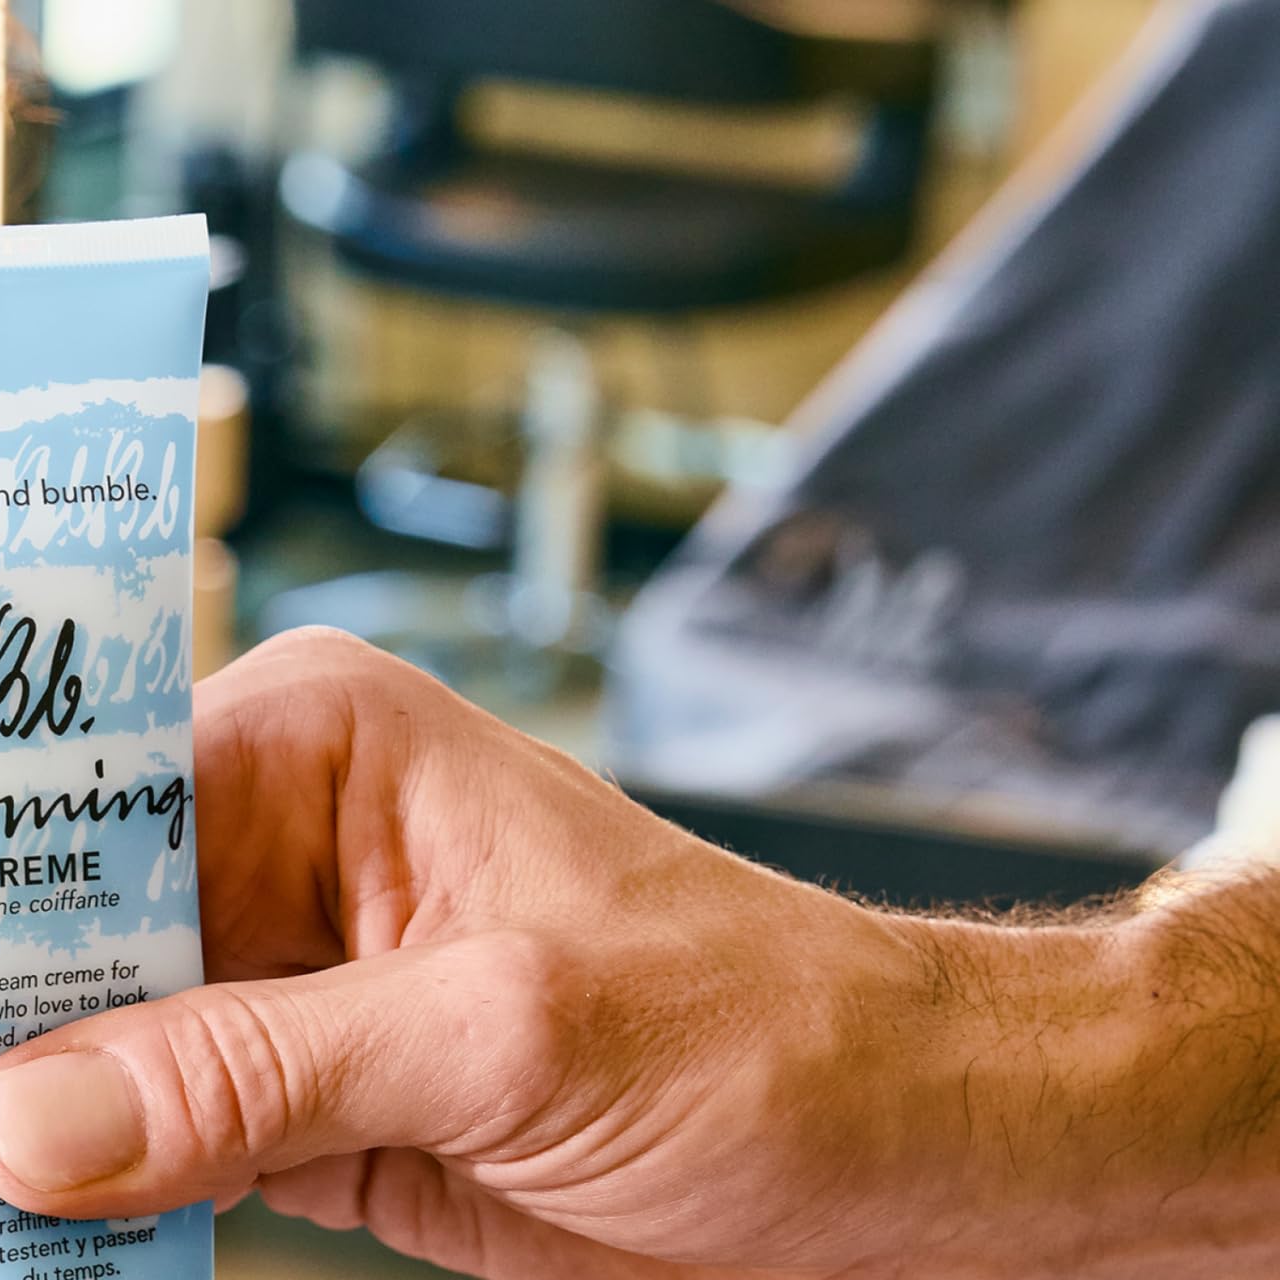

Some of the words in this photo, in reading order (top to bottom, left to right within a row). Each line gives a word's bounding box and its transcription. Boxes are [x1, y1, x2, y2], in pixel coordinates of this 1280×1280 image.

[41, 474, 158, 505] bumble.
[29, 889, 120, 914] coiffante
[44, 968, 105, 987] creme
[111, 960, 140, 980] for
[34, 995, 73, 1016] love
[79, 993, 100, 1011] to
[106, 985, 149, 1008] look
[75, 1237, 87, 1257] y
[93, 1226, 156, 1256] passer
